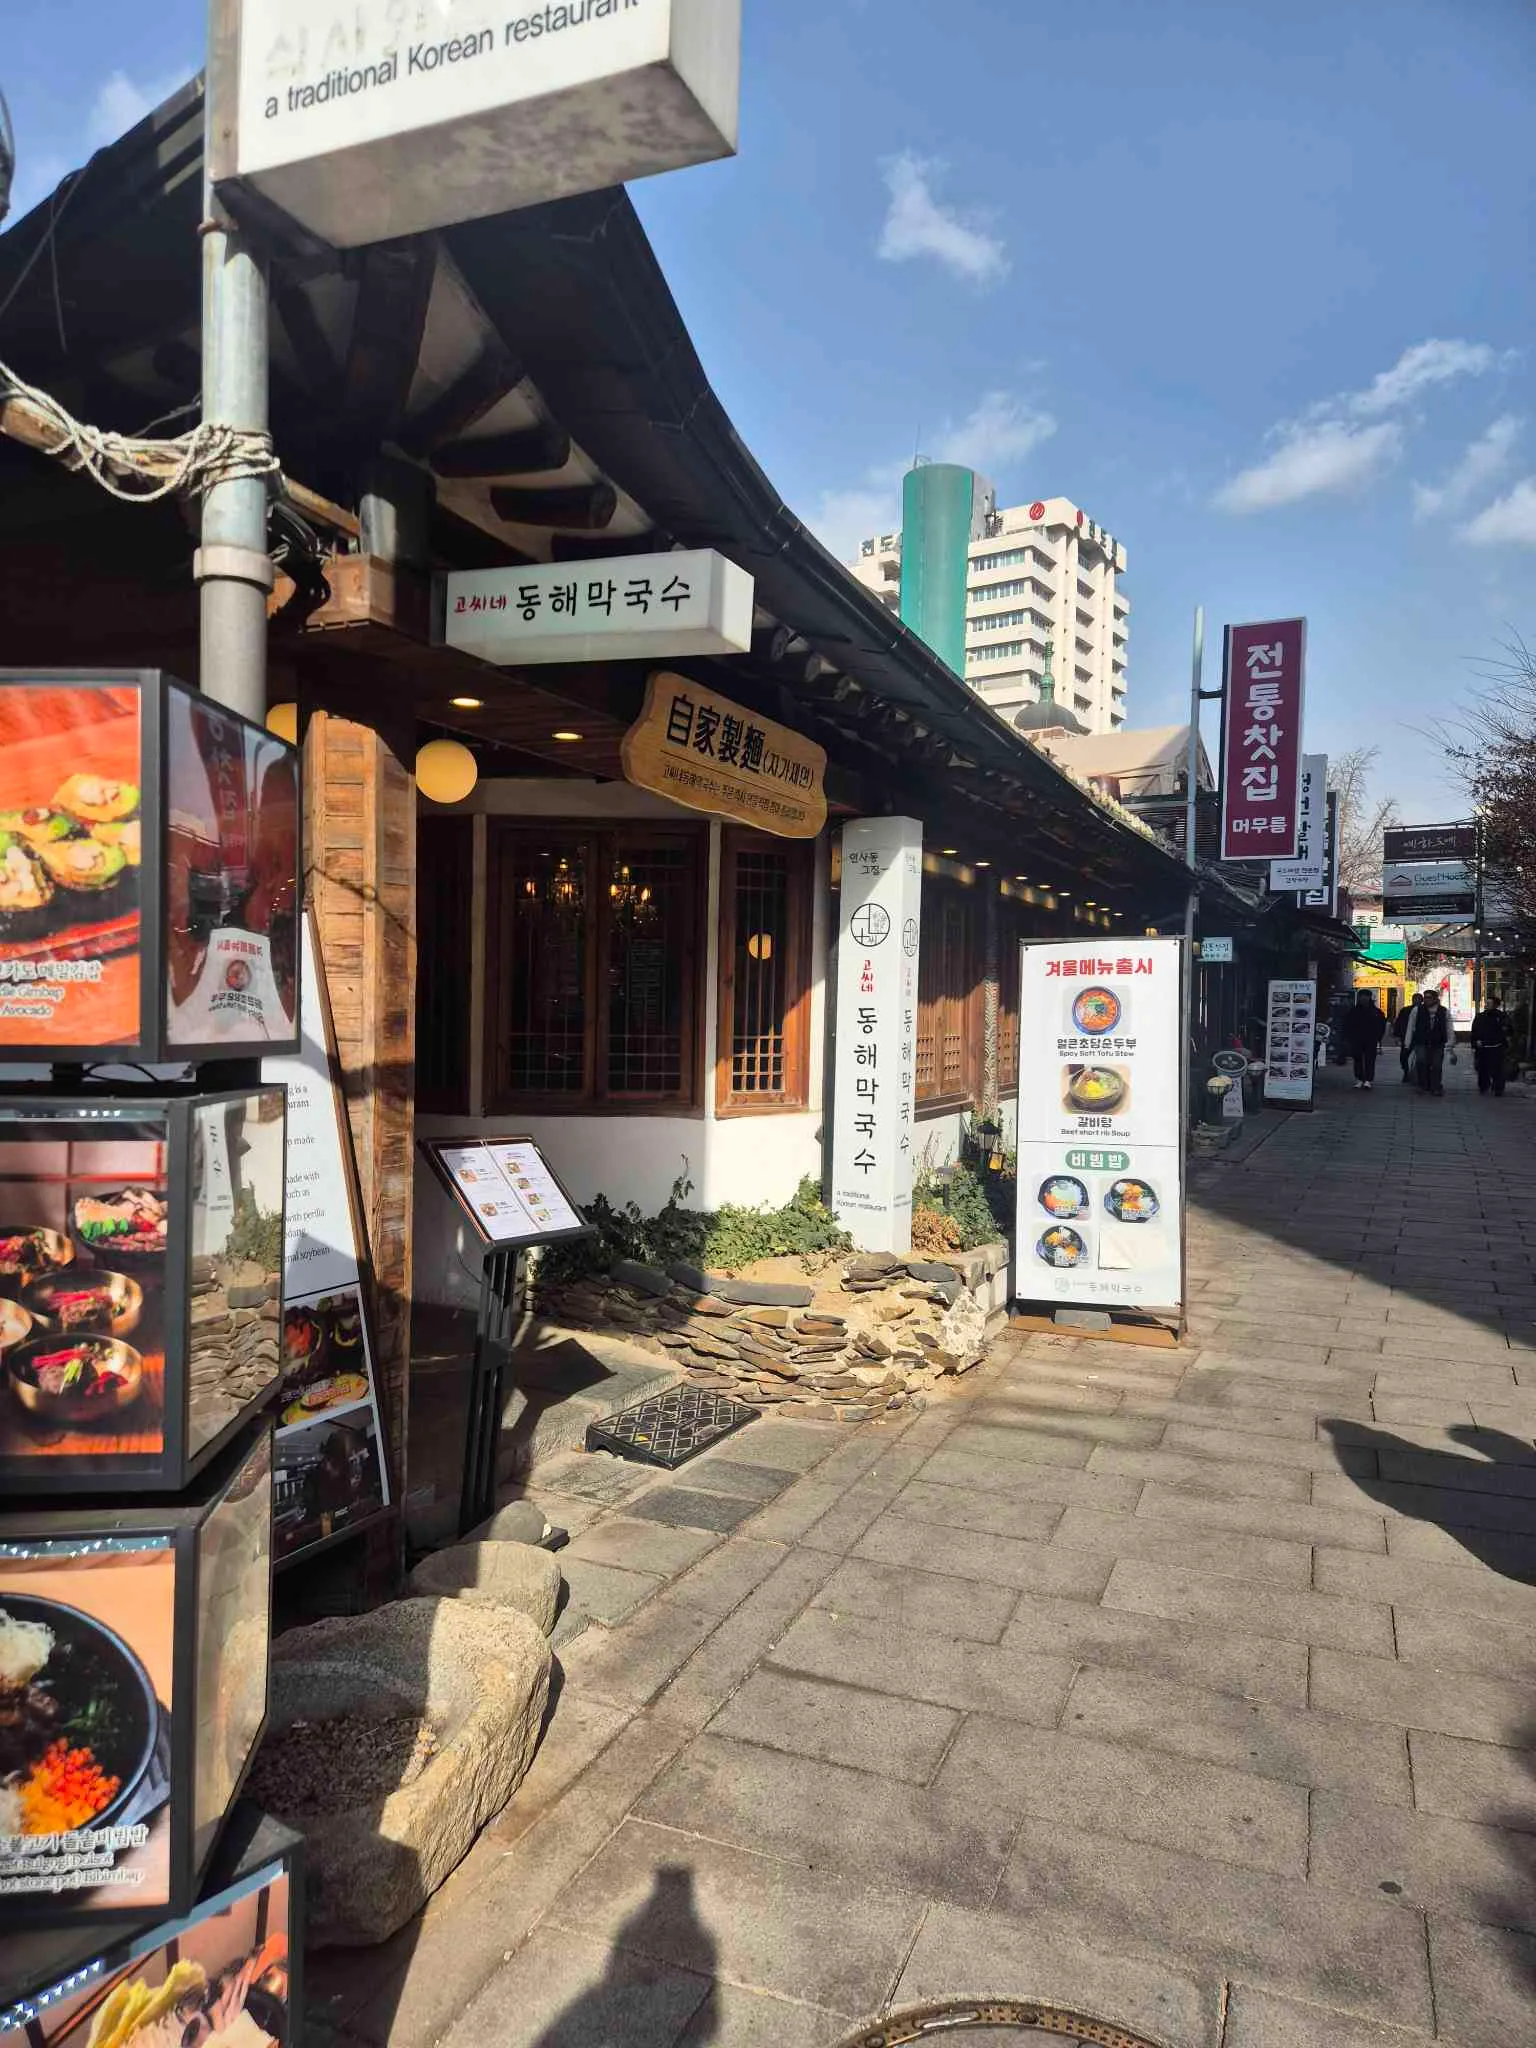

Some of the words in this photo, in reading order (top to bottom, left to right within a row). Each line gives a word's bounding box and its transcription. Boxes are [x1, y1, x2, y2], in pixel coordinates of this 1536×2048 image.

[265, 96, 279, 119] a
[287, 52, 398, 111] traditional
[407, 28, 493, 75] Korean
[504, 0, 639, 46] restaura
[454, 595, 507, 614] 고씨네
[516, 576, 691, 621] 동해막국수
[1241, 641, 1284, 802] 전통찻집
[1232, 816, 1288, 834] 머무름
[849, 852, 879, 864] 인사동
[860, 959, 874, 993] 고씨네
[1045, 957, 1153, 977] 겨울메뉴출시
[2, 1003, 52, 1018] Avocado
[1057, 1038, 1136, 1049] 얼큰초당순두부
[1059, 1050, 1078, 1058] Spicy
[853, 1007, 879, 1175] 동해막국수
[1078, 1116, 1112, 1128] 갈비탕
[1071, 1152, 1122, 1169] 비빔밥
